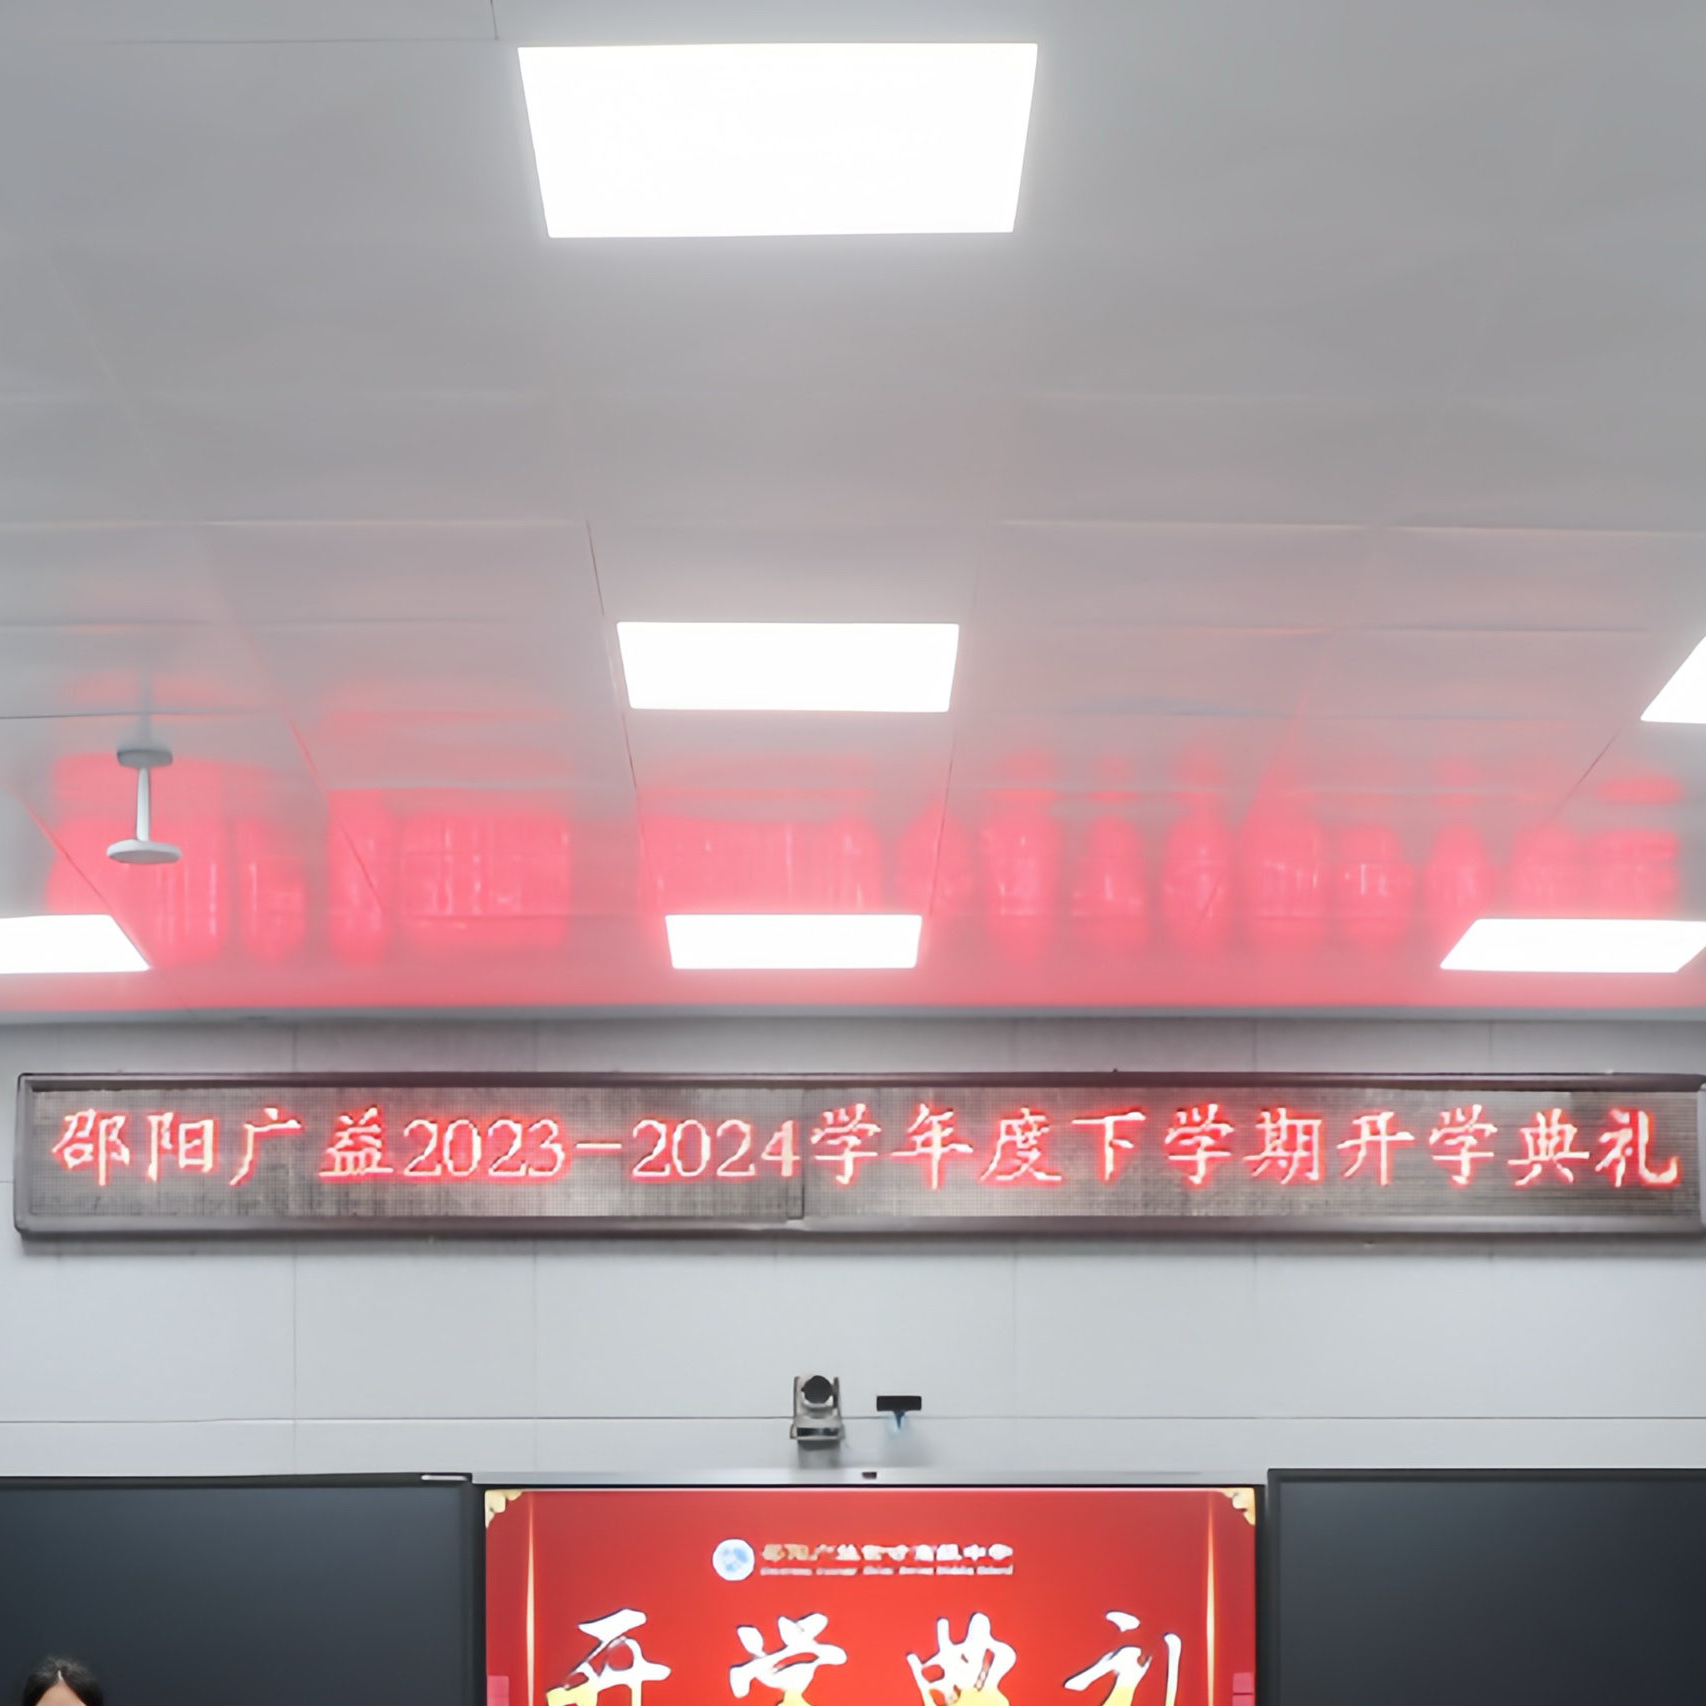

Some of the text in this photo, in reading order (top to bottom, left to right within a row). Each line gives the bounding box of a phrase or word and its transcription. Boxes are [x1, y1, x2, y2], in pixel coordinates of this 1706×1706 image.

[51, 1103, 1680, 1188] 邵阳广益2023-2024学年度下学期开学典礼
